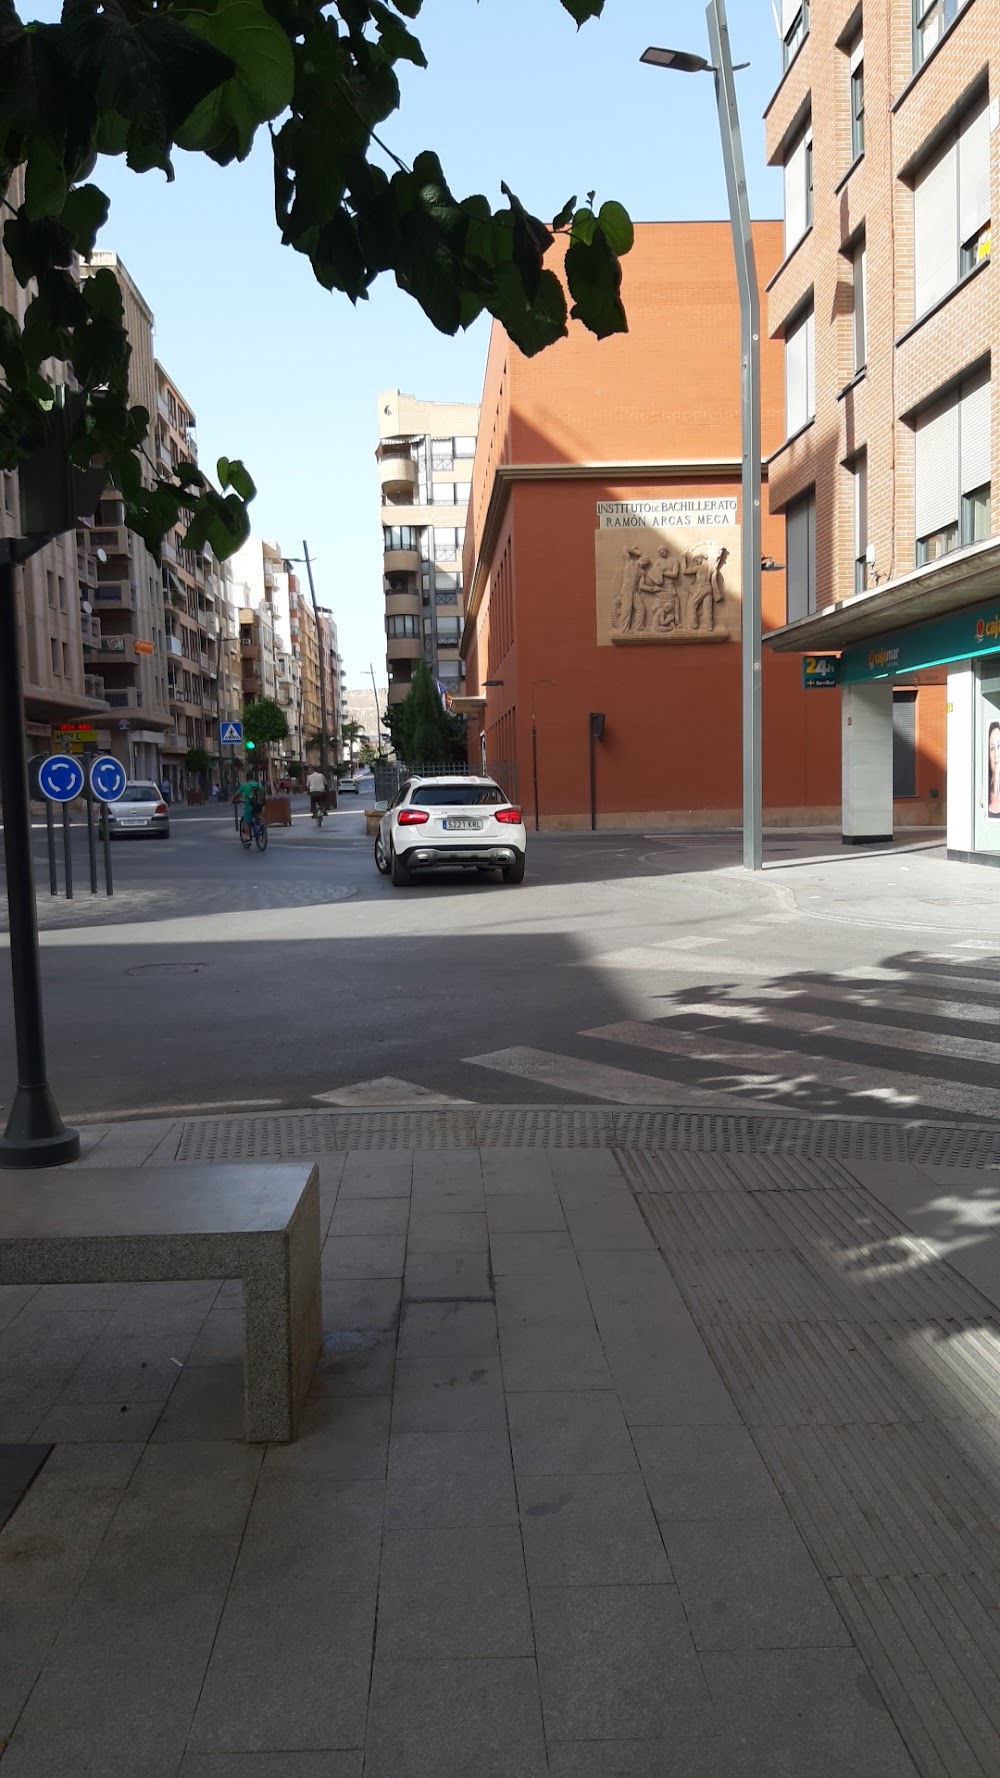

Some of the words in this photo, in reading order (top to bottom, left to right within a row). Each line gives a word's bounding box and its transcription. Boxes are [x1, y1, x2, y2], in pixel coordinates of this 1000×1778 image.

[597, 503, 651, 514] INSTITUTO
[661, 500, 737, 512] BACHILLERATO
[606, 514, 646, 528] RAMÓN
[652, 515, 691, 526] ARCAS
[697, 514, 730, 525] MECA
[985, 614, 1000, 640] caj
[806, 657, 834, 676] 24h
